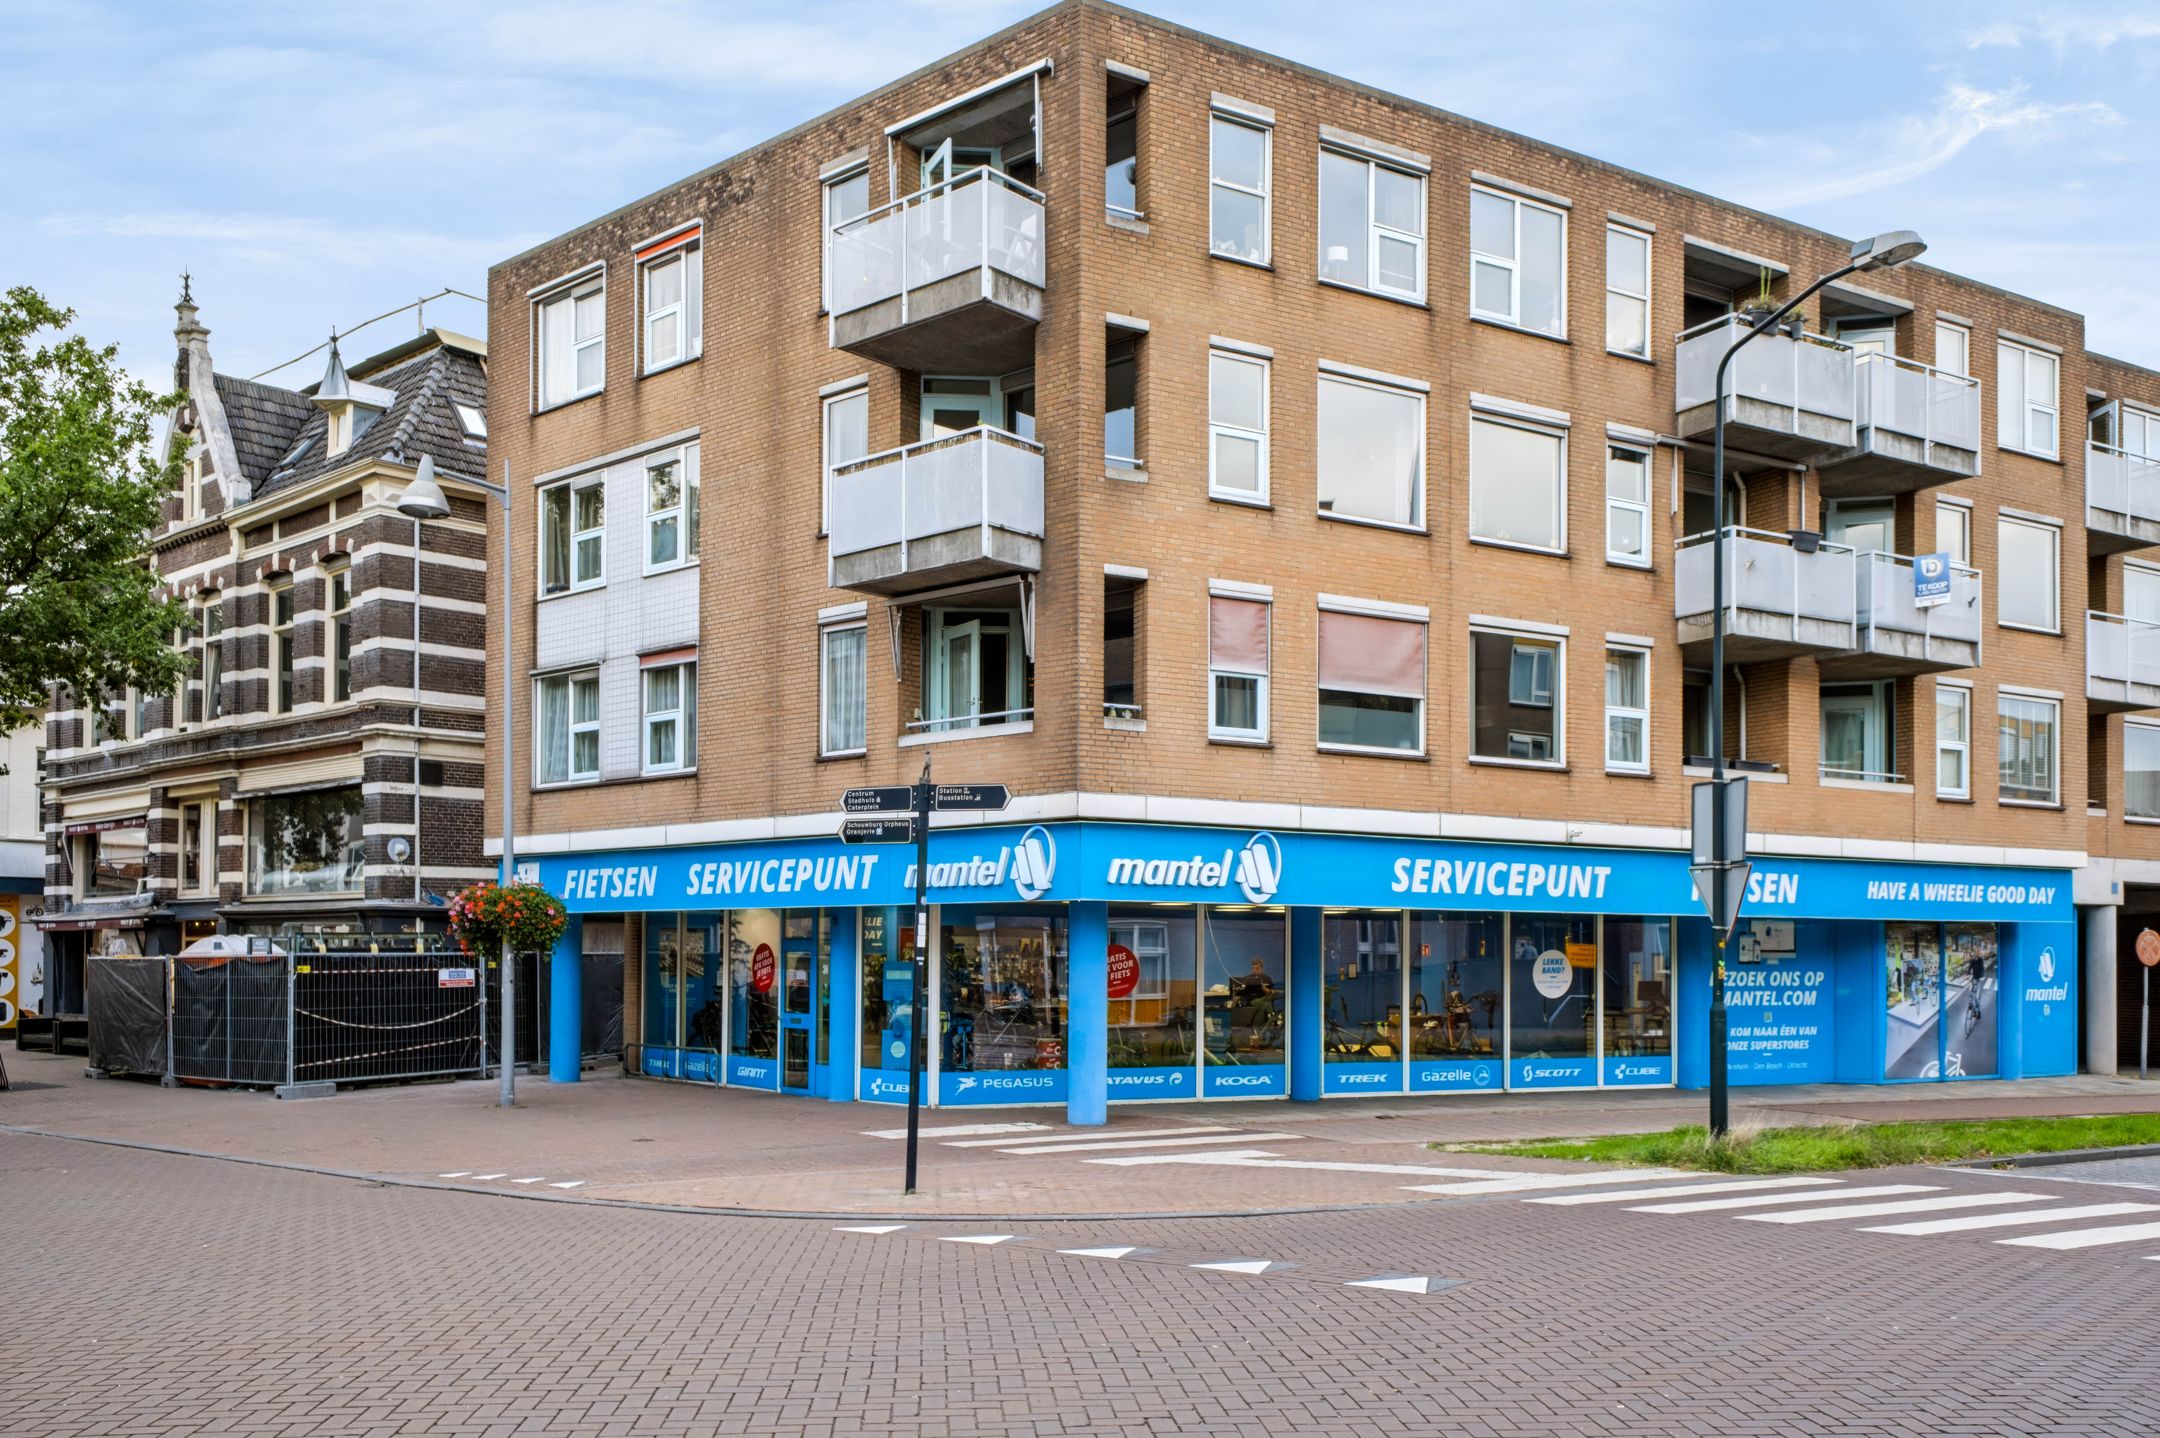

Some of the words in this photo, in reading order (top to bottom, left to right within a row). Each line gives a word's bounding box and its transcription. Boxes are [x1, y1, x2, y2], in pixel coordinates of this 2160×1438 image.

[904, 846, 1011, 888] mantel
[1107, 848, 1233, 887] mantel
[686, 855, 879, 896] SERVICEPUNT
[1391, 857, 1611, 899] SERVICEPUNT
[564, 866, 657, 899] FIETSEN
[1867, 881, 1907, 900] HAVE
[1909, 883, 1920, 901] A
[1923, 883, 1984, 903] WHEELIE
[1987, 886, 2025, 904] GOOD
[2028, 887, 2056, 905] DAY
[1108, 953, 1127, 963] ATIS
[1112, 960, 1134, 971] VOOR
[1110, 969, 1131, 980] FIETS
[1770, 971, 1800, 987] ONS
[1804, 971, 1825, 987] OP
[2025, 982, 2068, 1001] mantel
[1730, 1027, 1751, 1037] KOM
[1753, 1027, 1778, 1036] NAAR
[1799, 1026, 1818, 1035] VAN
[1750, 1040, 1809, 1050] SUPERSTORES
[737, 1066, 768, 1078] GIANT
[1422, 1069, 1471, 1082] Gazelle
[1534, 1068, 1582, 1078] SCOTT
[1625, 1067, 1661, 1075] CUBE
[983, 1077, 1054, 1088] PEGASUS
[1107, 1076, 1165, 1085] ATAVUS
[1215, 1076, 1272, 1086] KOGA
[1338, 1074, 1388, 1083] TREK
[881, 1082, 909, 1093] CUB
